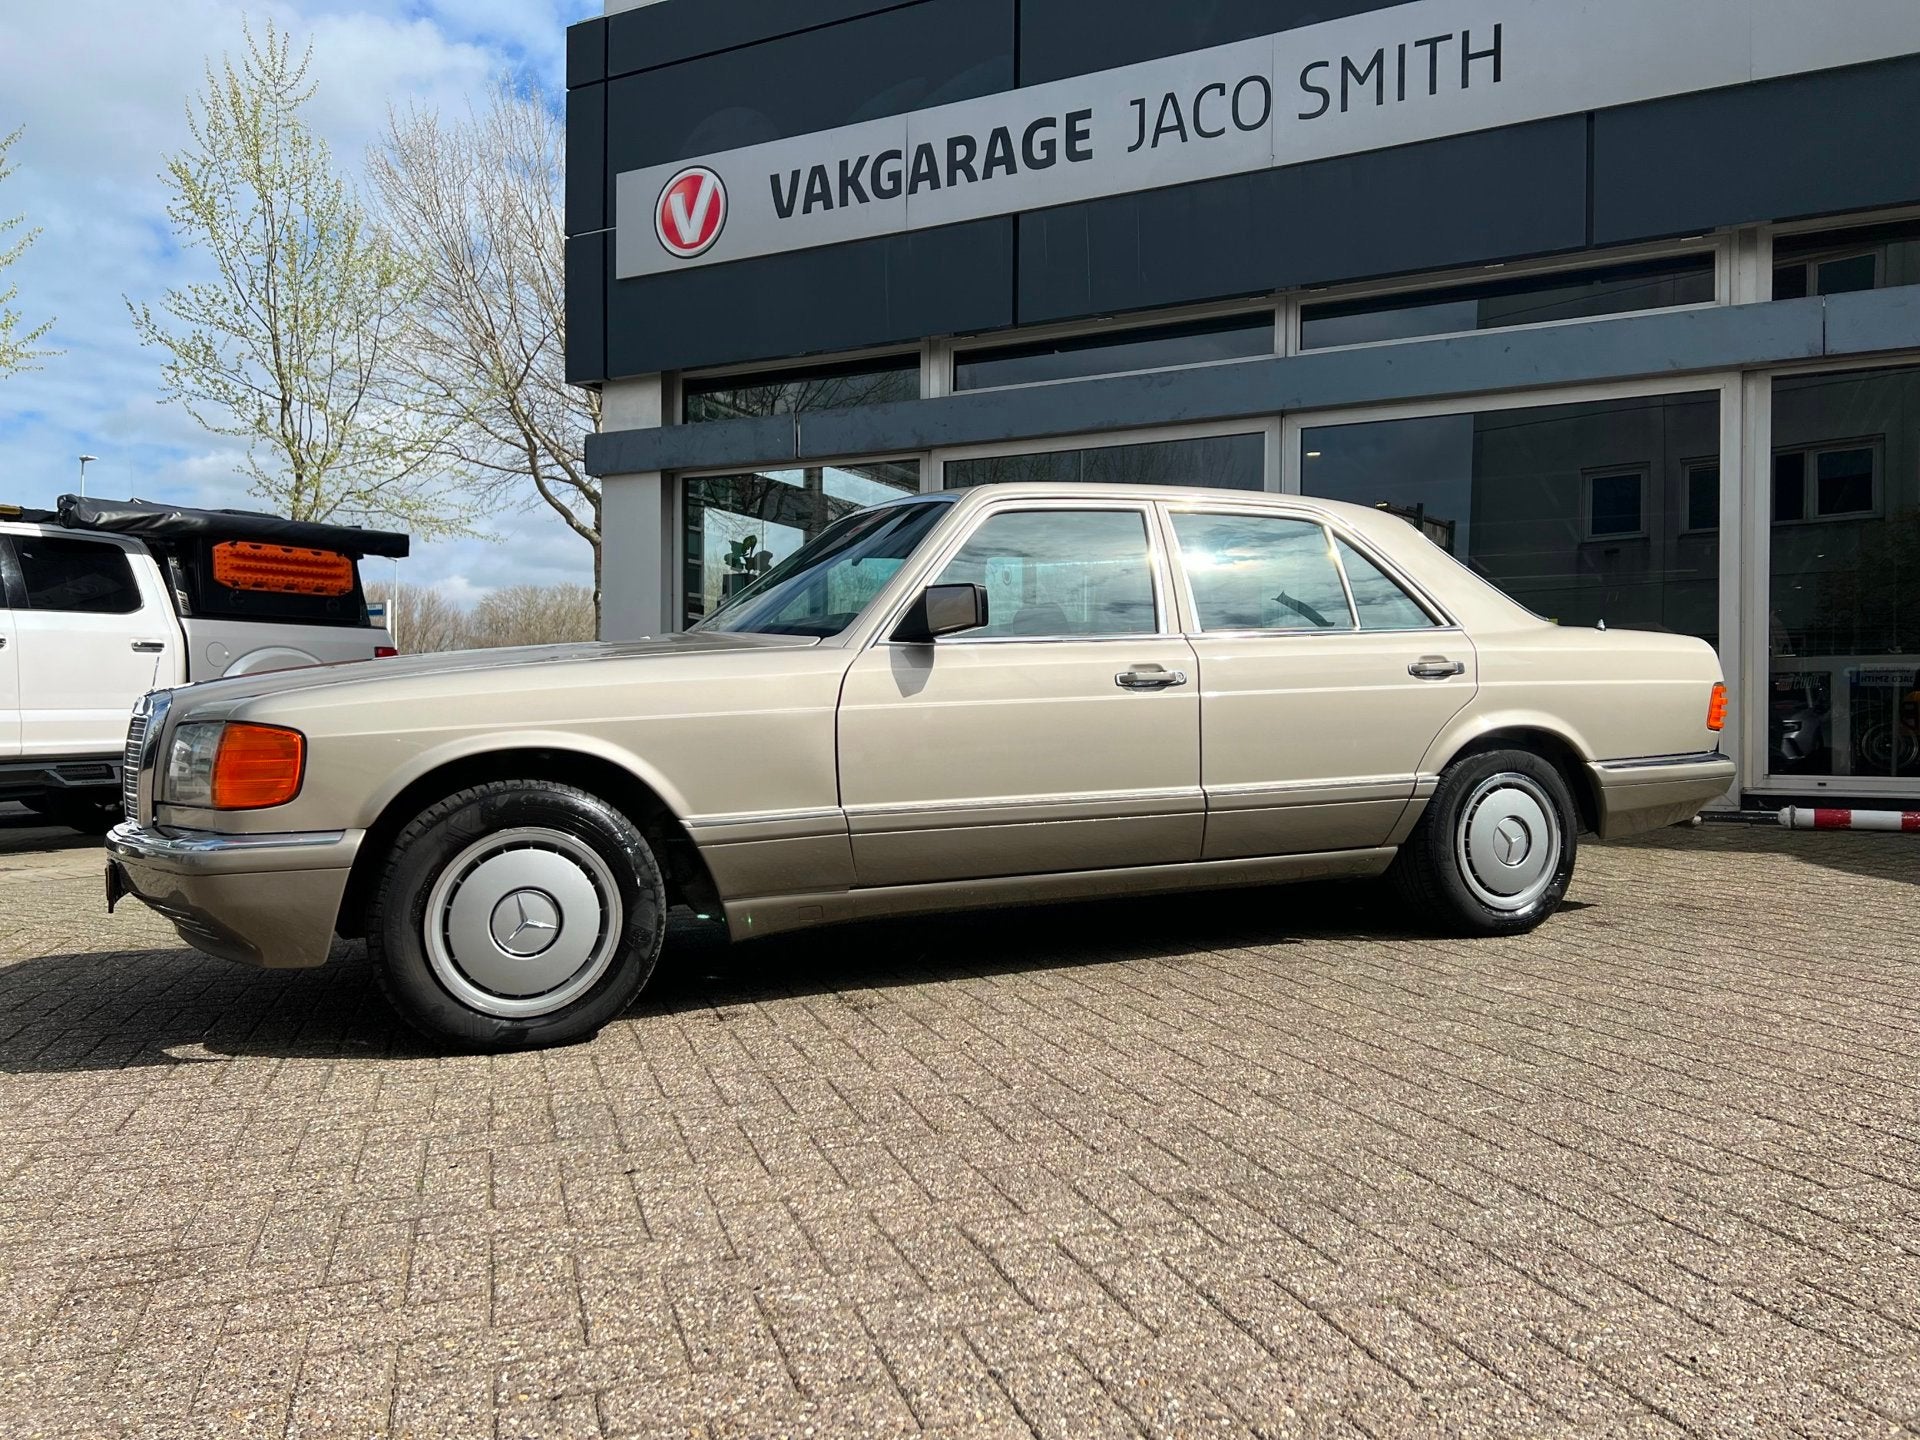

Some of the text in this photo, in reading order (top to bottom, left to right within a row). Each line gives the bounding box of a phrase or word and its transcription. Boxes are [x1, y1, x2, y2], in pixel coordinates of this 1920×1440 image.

[769, 22, 1503, 220] VAKGARAGE JACO SMITH
[669, 169, 717, 245] V
